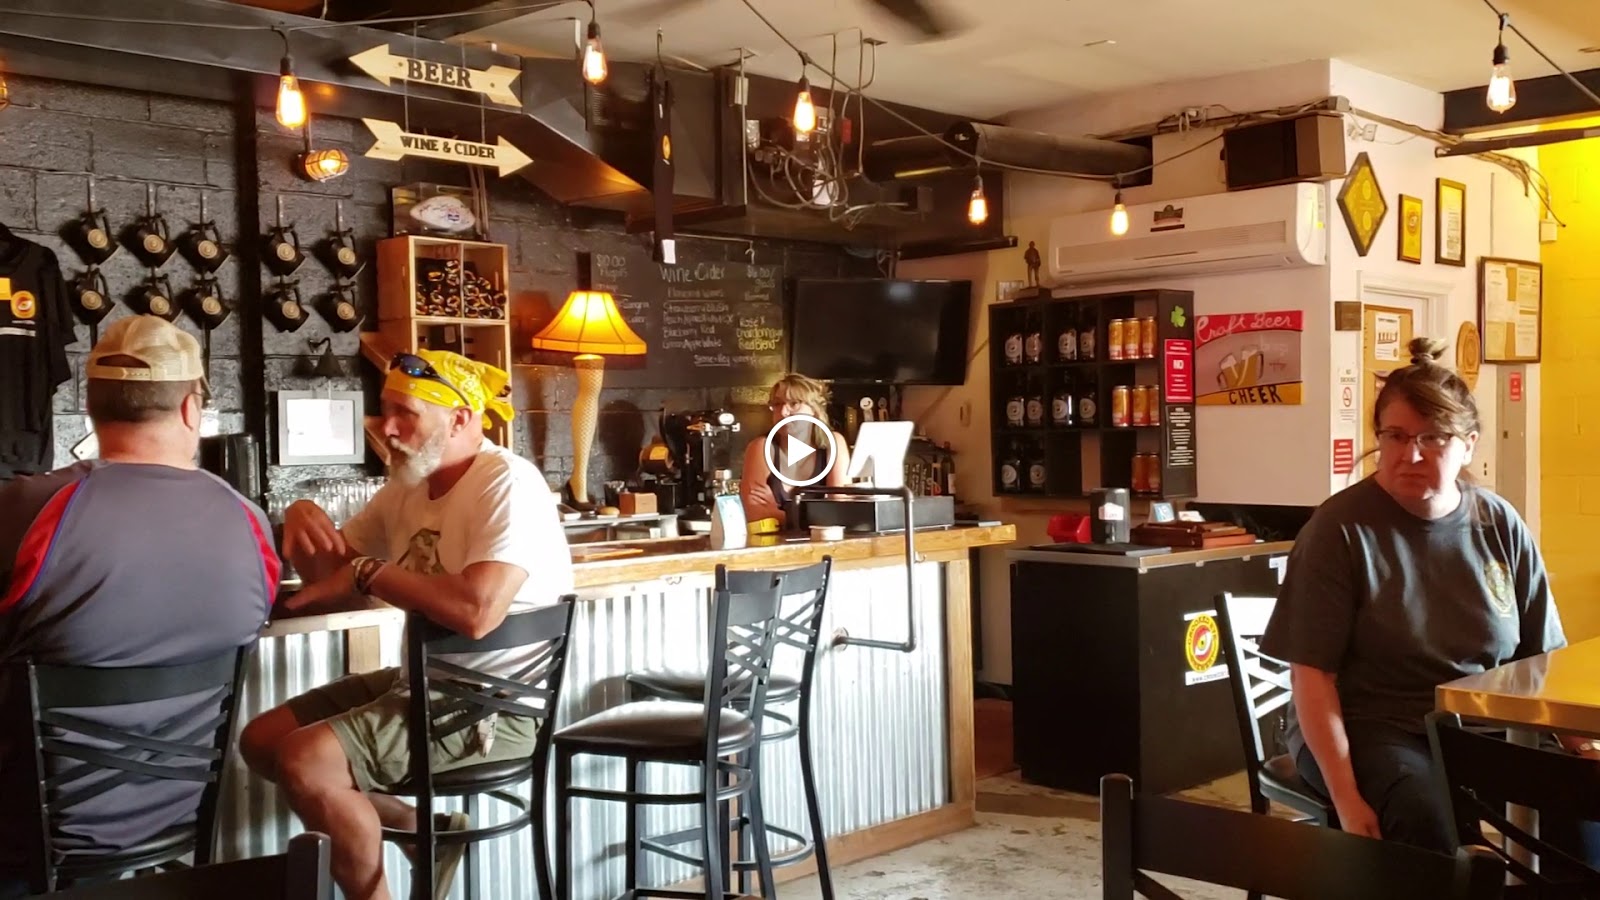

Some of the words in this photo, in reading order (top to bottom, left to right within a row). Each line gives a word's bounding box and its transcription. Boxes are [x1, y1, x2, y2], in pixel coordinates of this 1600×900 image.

[407, 58, 473, 89] BEER
[401, 136, 440, 152] WINE
[442, 143, 452, 154] &
[454, 144, 496, 159] CIDER
[1250, 313, 1292, 329] Beer
[1229, 384, 1283, 405] CHEER
